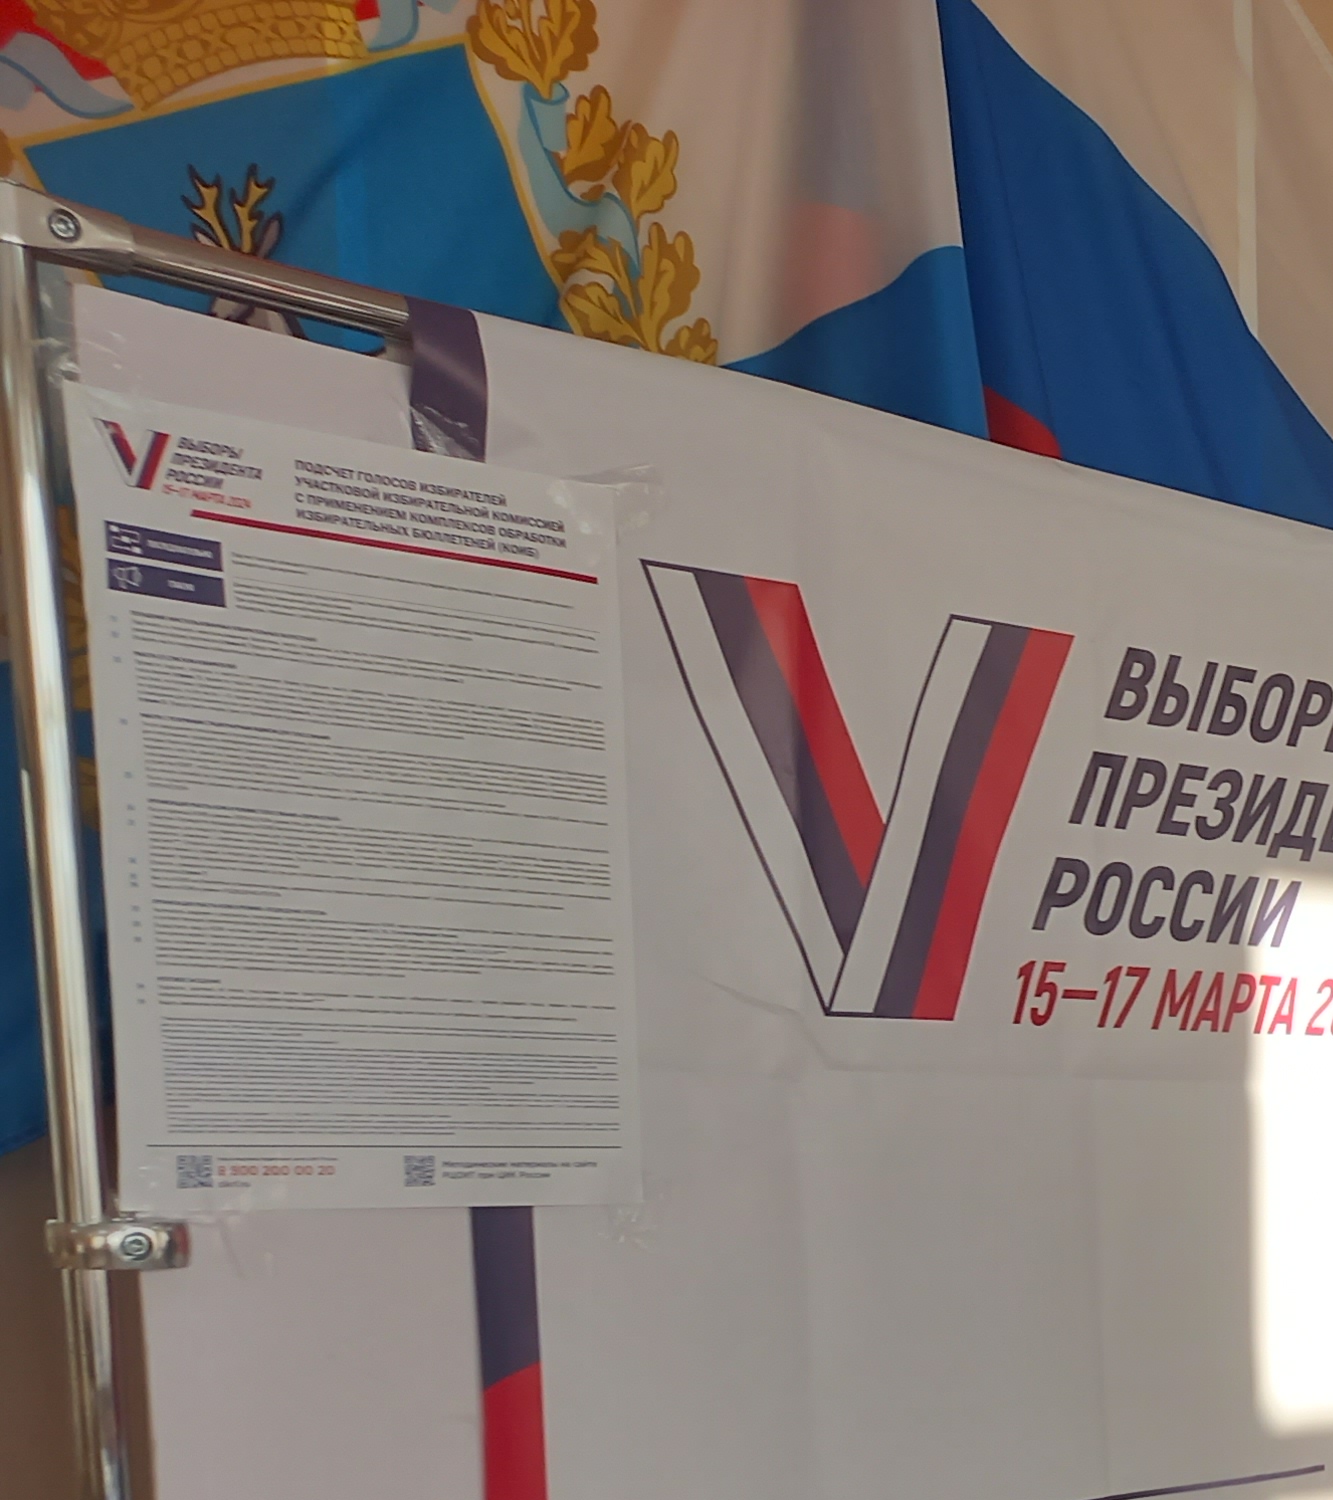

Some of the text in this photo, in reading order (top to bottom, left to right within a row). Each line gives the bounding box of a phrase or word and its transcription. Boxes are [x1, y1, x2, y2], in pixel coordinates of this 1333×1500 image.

[170, 452, 263, 480] ПРЕЗИДЕНТА
[177, 436, 244, 460] ВЫБОРЫ
[165, 468, 224, 489] РОССИИ
[294, 459, 507, 507] ПОДСЧЕТ ГОЛОСОВ ИЗБИРАТЕЛЕЙ
[294, 475, 566, 533] УЧАСТКОВОЙ ИЗБИРАТЕЛЬНОЙ КОМИССИЕЙ
[294, 492, 567, 549] С ПРИМЕНЕНИЕМ КОМПЛЕКСОВ ОБРАБОТКИ
[295, 508, 539, 560] ИЗБИРАТЕЛЬНЫХ БЮЛЛЕТЕНЕЙ (КОИБ)
[1031, 856, 1302, 948] РОССИИ
[1150, 968, 1299, 1036] МАРТА
[262, 1165, 290, 1176] 200
[294, 1165, 314, 1176] 00
[317, 1165, 336, 1176] 20
